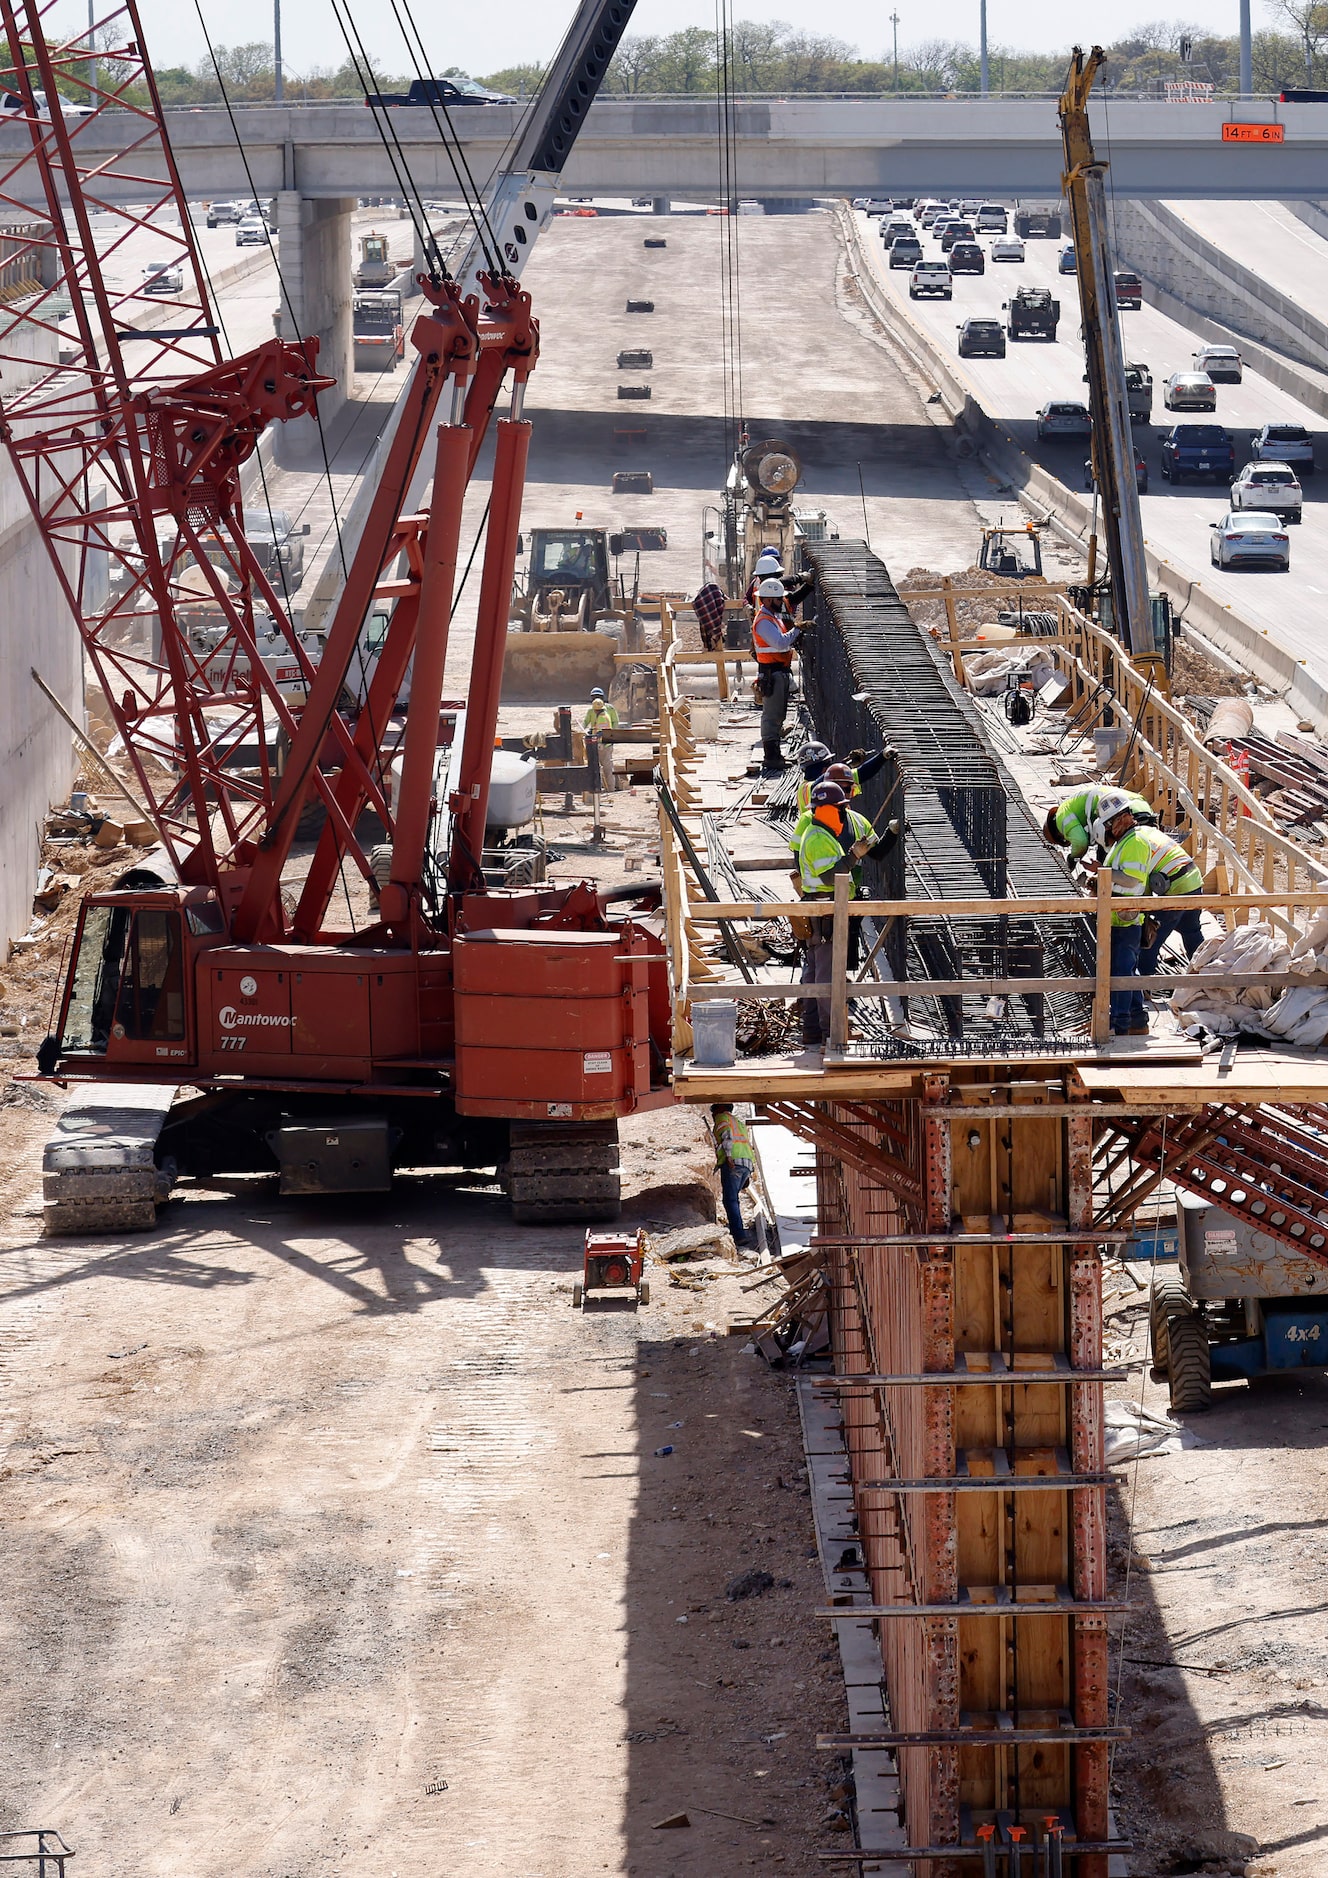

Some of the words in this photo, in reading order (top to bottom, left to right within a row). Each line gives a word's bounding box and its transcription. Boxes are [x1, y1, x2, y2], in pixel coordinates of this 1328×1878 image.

[1225, 127, 1239, 138] 14
[1241, 130, 1251, 138] FT
[1262, 128, 1270, 139] 6
[218, 1005, 298, 1029] Manitowoc
[220, 1036, 247, 1050] 777
[1285, 1324, 1321, 1342] 4x4
